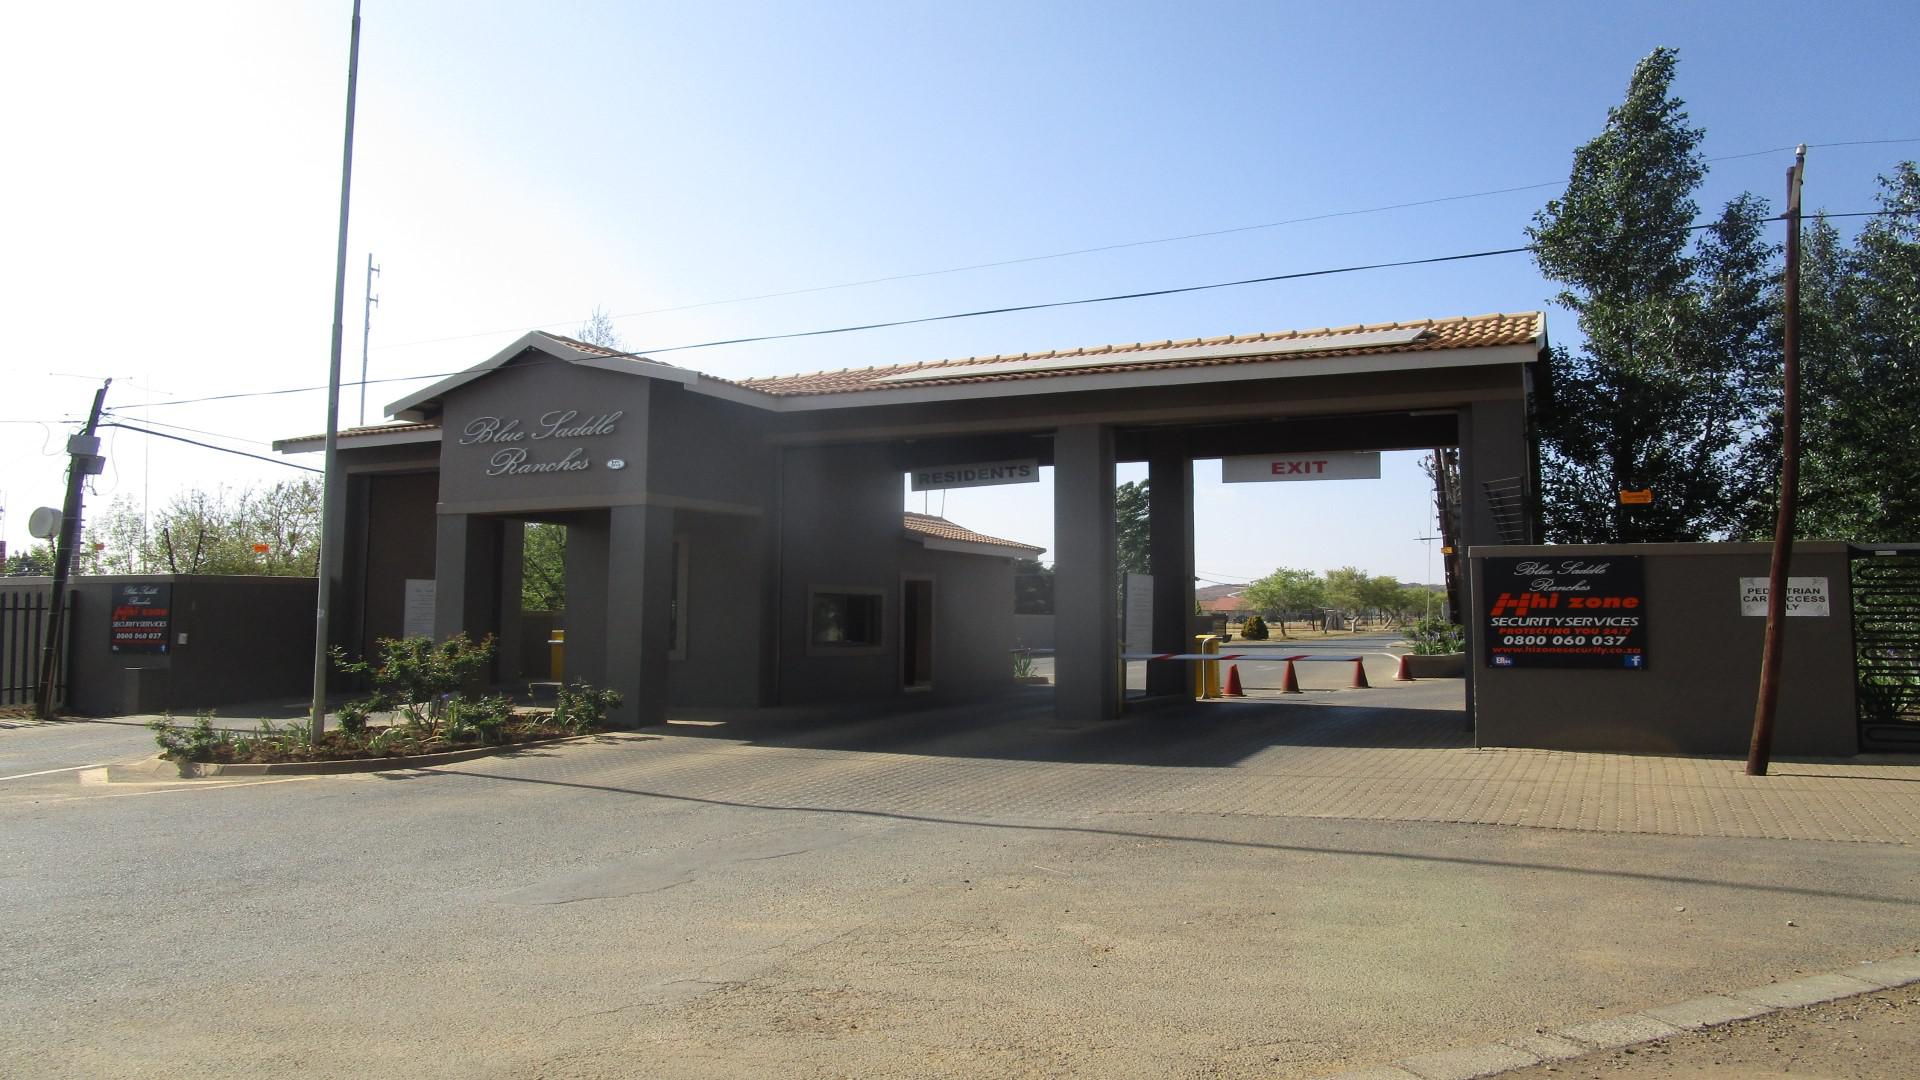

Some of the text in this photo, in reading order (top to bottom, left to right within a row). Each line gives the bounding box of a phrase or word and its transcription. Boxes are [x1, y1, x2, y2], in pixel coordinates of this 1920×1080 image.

[459, 410, 623, 445] Blue Saddle
[486, 447, 589, 476] Ranches
[1271, 460, 1328, 475] EXIT
[918, 465, 1031, 485] RESIDENTS
[1513, 560, 1611, 576] Blue Saddle
[1529, 577, 1591, 592] Ranches
[1747, 587, 1820, 595] PEDTRIAN
[1568, 596, 1640, 609] zone
[1743, 595, 1826, 603] CAR CCESS
[1498, 627, 1632, 635] PROTECTING YOU 24/7
[1503, 635, 1627, 646] 0800 060 037
[1492, 646, 1641, 655] www.hizonesecurity.co.za
